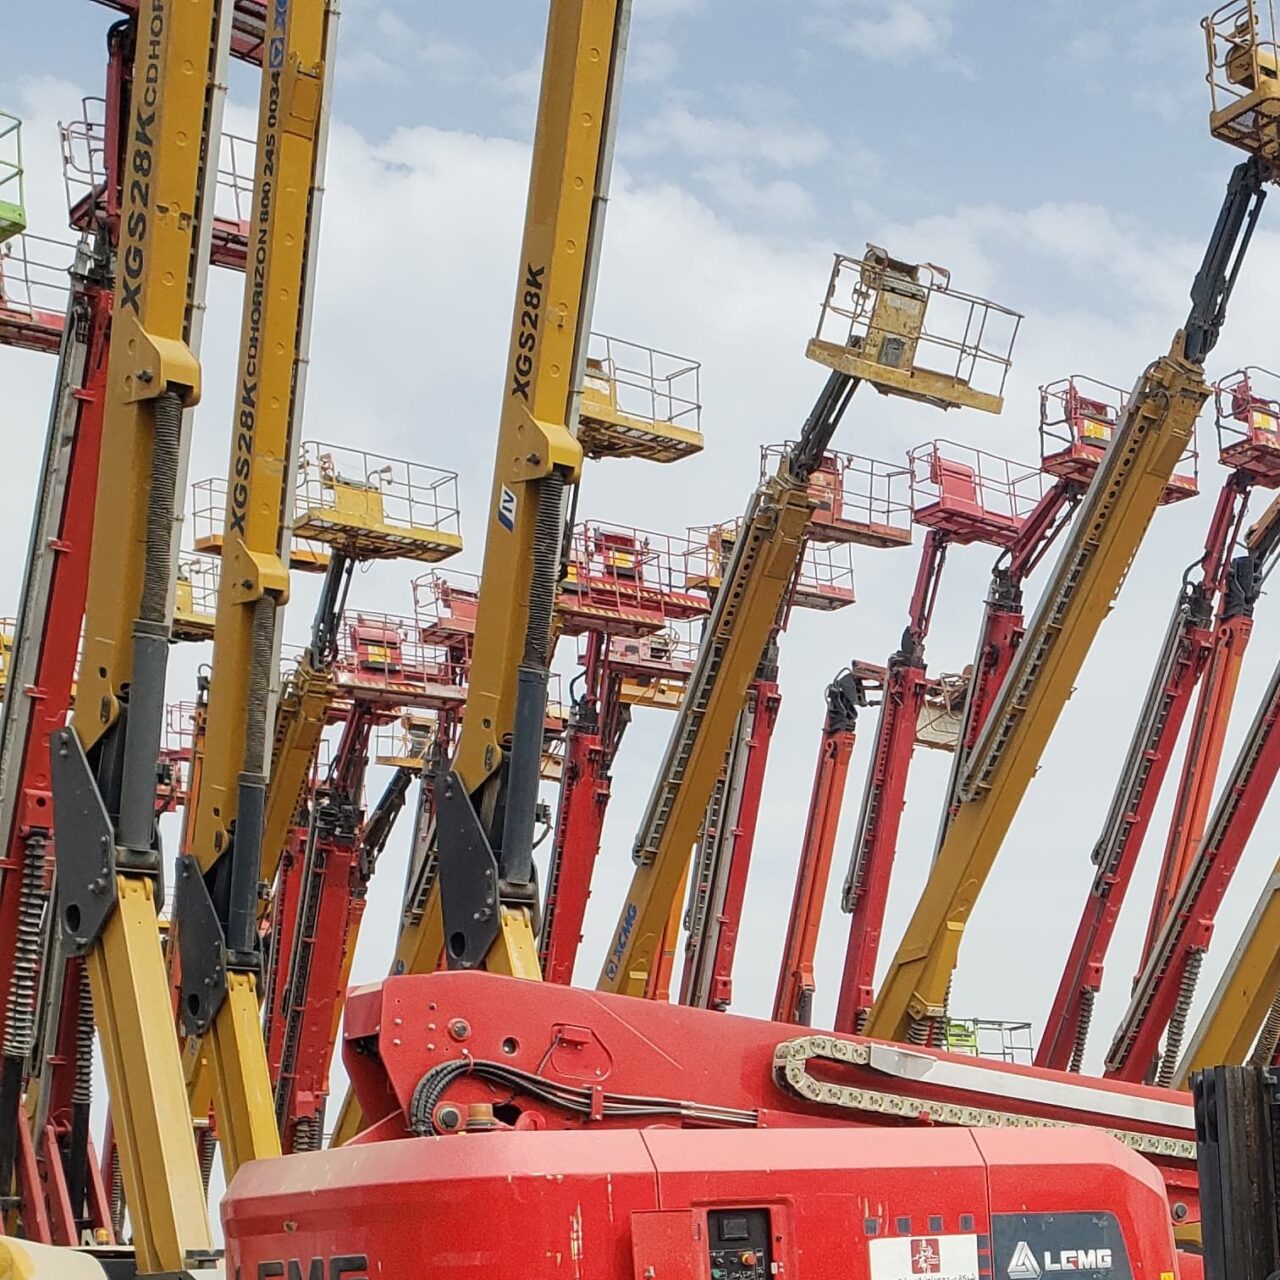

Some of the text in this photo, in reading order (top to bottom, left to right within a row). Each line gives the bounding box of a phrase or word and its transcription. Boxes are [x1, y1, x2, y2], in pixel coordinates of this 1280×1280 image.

[260, 182, 271, 224] 800
[264, 133, 276, 177] 245
[121, 103, 156, 316] XGS28K
[246, 229, 268, 378] CDHORIZON
[512, 263, 545, 402] XGS28K
[230, 379, 258, 537] XGS28K
[614, 903, 637, 961] XCMG
[1043, 1249, 1113, 1271] LGMG
